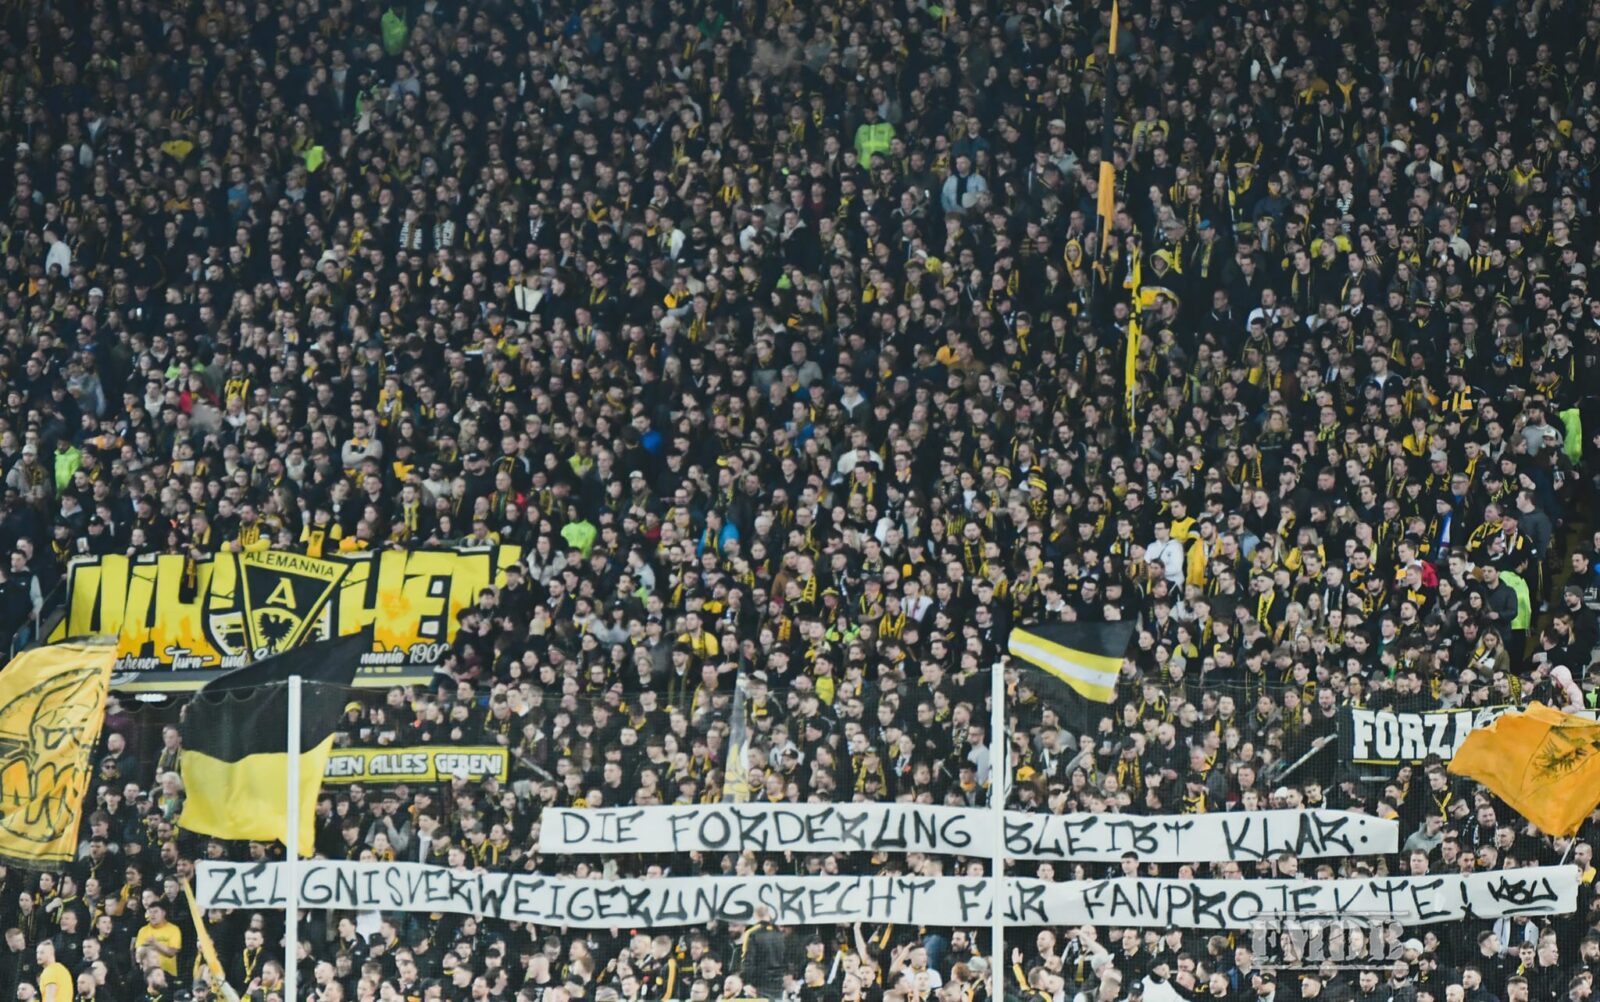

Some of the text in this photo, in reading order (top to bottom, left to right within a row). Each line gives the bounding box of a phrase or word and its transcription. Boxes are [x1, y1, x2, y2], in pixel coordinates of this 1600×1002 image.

[245, 551, 335, 577] ALEMANNIA
[265, 577, 297, 609] A
[325, 756, 364, 776] HEN
[370, 753, 428, 775] ALLES
[561, 806, 1369, 860] DIE FORDERUNG BLEIBT KLAR:
